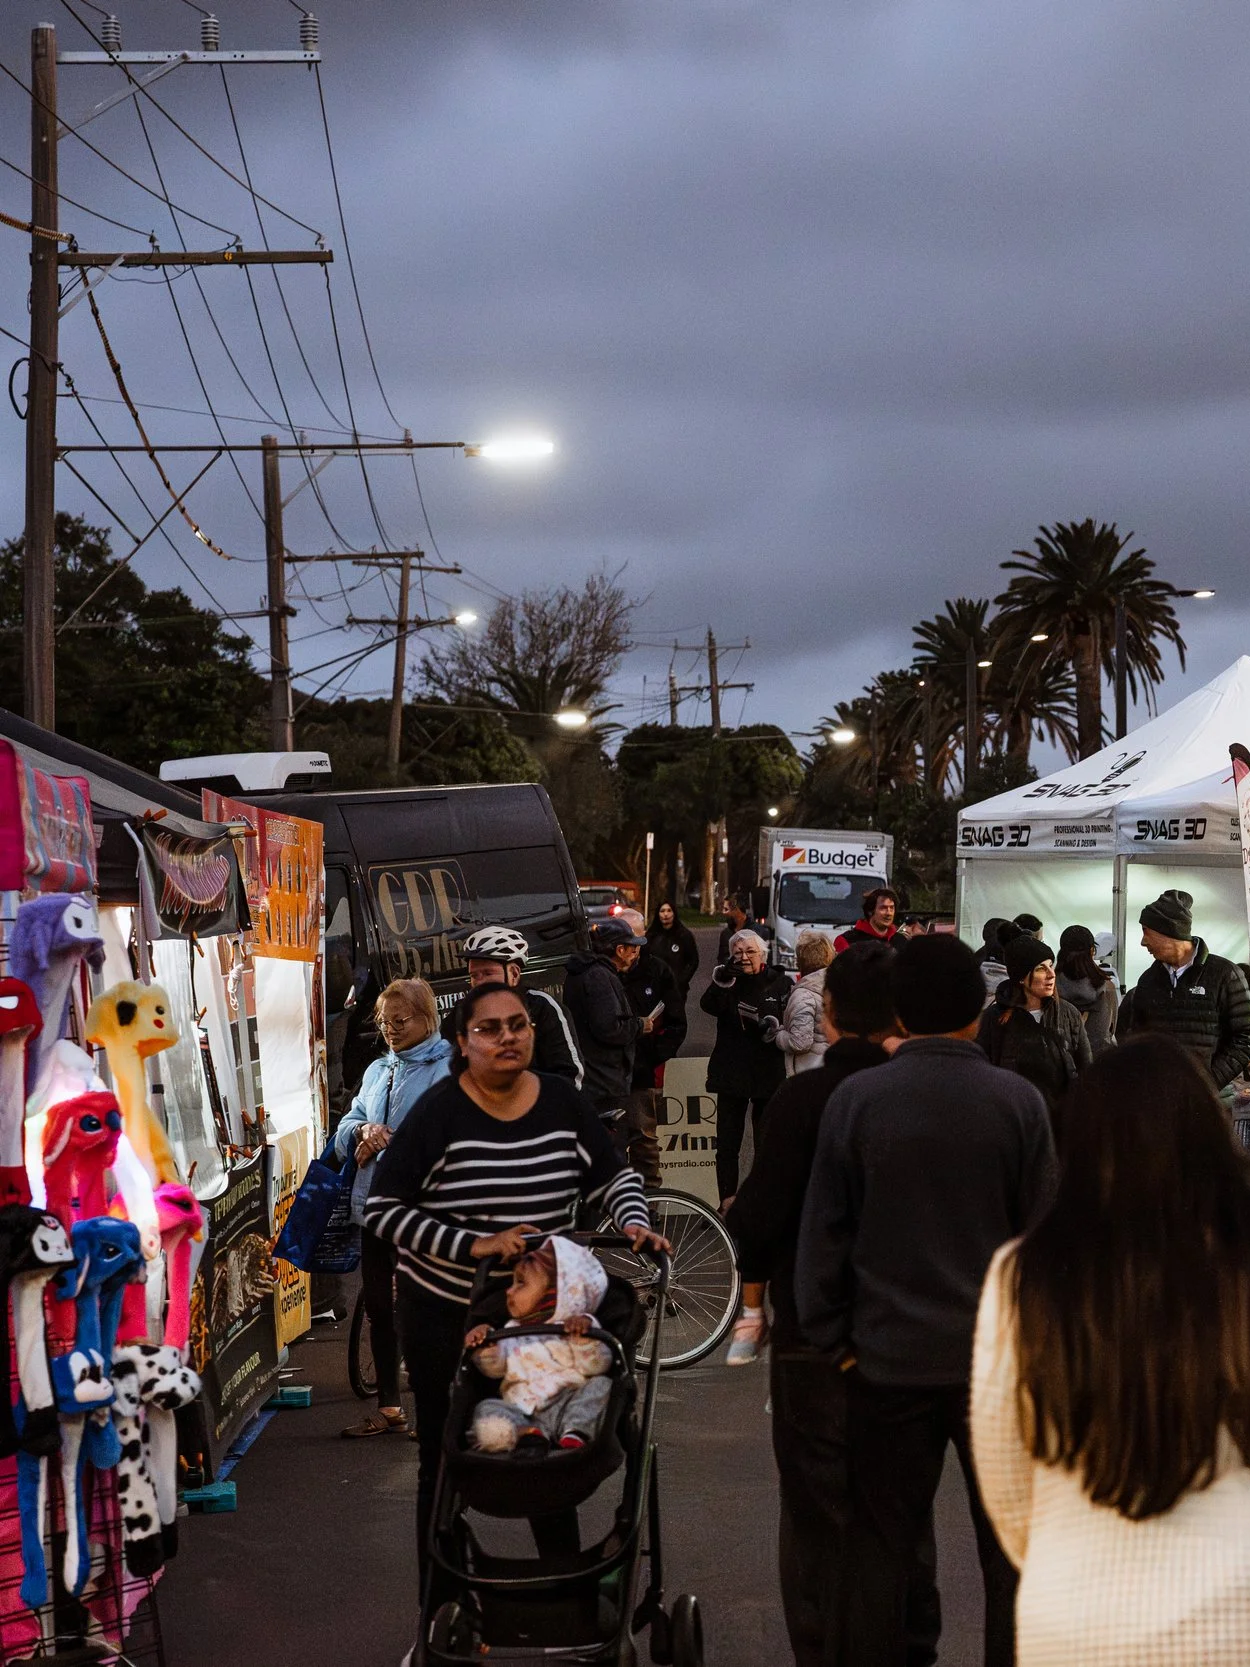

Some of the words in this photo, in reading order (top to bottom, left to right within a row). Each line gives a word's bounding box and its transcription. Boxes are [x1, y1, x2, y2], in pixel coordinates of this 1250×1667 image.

[1023, 783, 1094, 799] SNAG
[1087, 783, 1131, 797] 3D
[960, 825, 1005, 848] SNAG
[1006, 825, 1031, 847] 3D
[1133, 818, 1181, 840] SNAG
[1183, 818, 1207, 840] 3D
[808, 848, 875, 869] Budget
